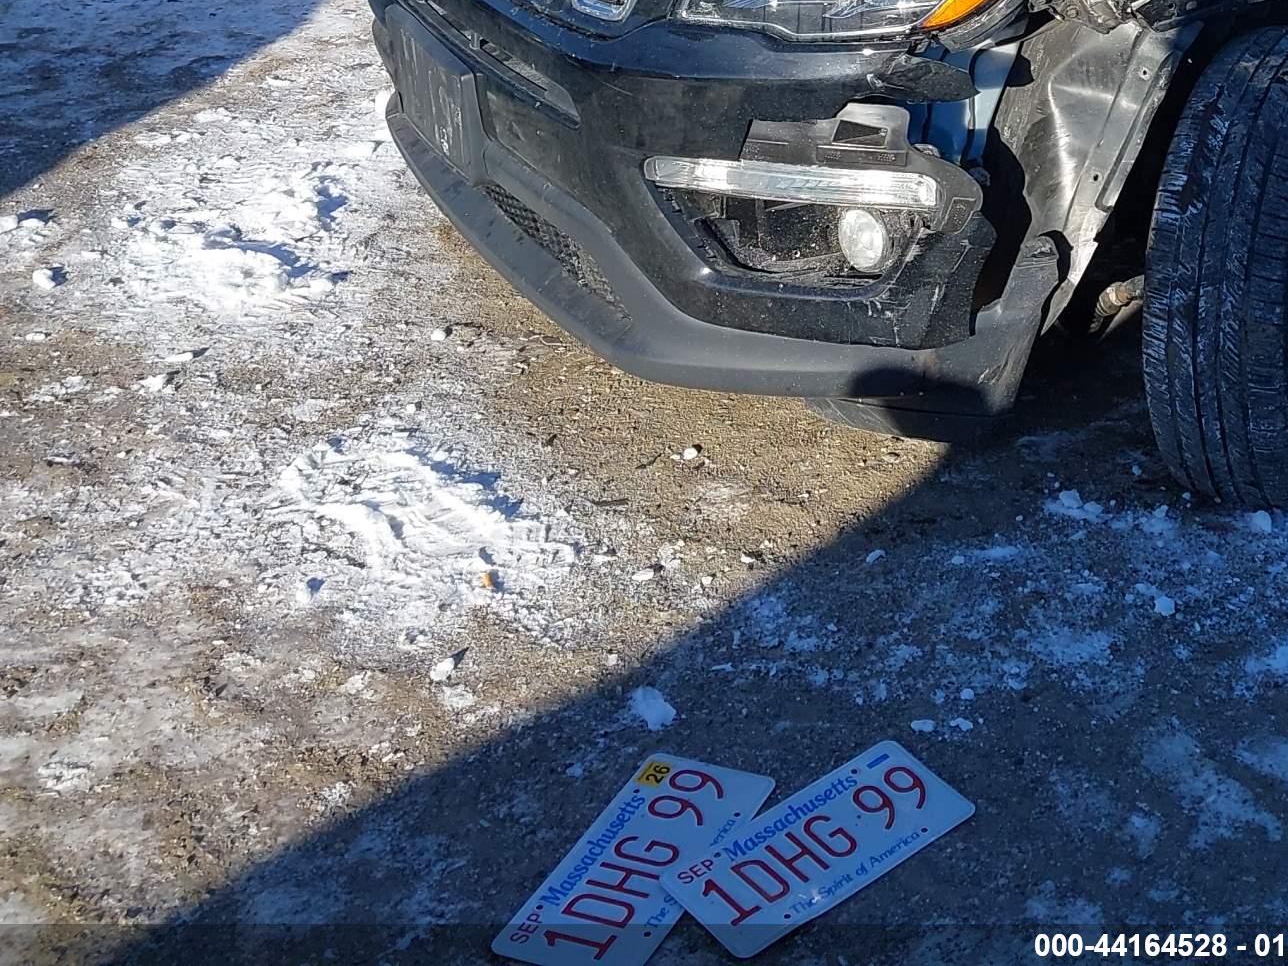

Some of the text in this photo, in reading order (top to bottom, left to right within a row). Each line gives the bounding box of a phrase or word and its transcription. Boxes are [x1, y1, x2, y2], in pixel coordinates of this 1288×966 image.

[645, 764, 671, 785] 26
[678, 774, 860, 885] SEP Massachusetts
[510, 794, 646, 945] SEP Massachusetts
[543, 768, 724, 961] 1DHG 99
[702, 766, 927, 927] 1DHG 99
[790, 831, 921, 915] The Spirit of America
[646, 904, 670, 930] The
